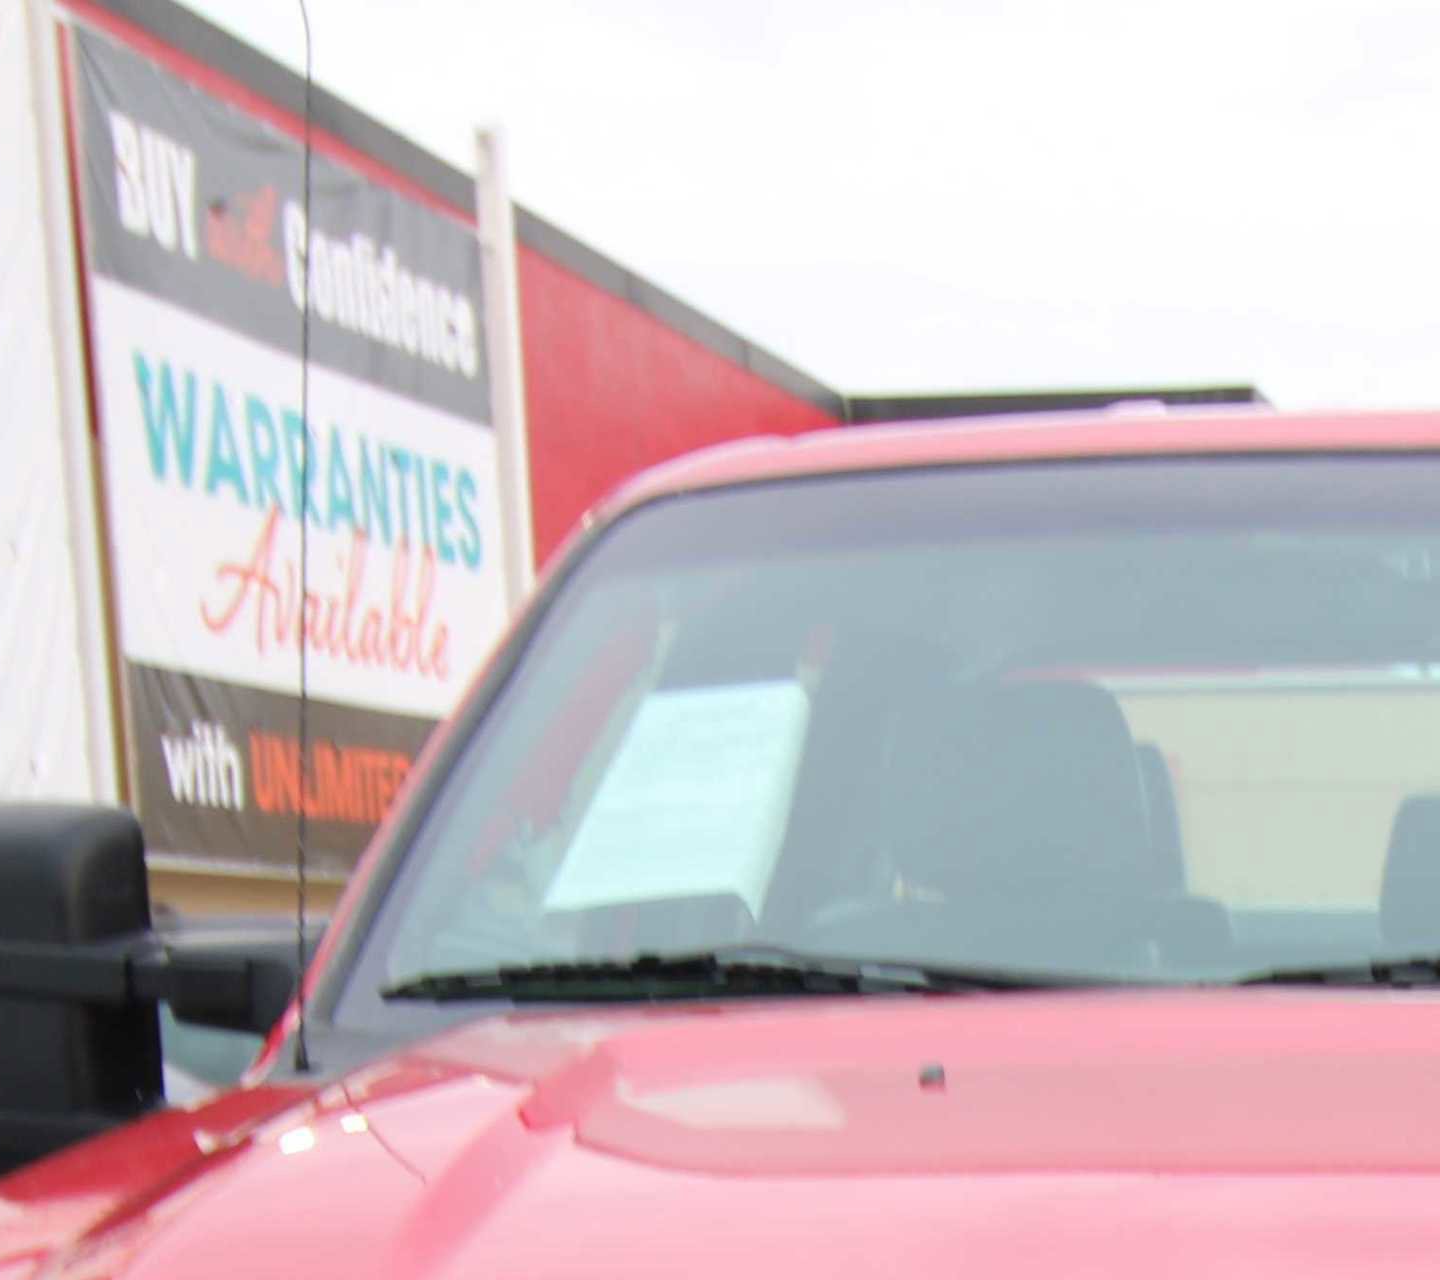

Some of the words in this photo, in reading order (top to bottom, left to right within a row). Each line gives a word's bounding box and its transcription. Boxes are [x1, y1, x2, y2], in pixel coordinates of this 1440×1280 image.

[109, 109, 197, 262] BUY
[282, 199, 478, 380] Confidence
[132, 349, 482, 570] WARRANTIES
[201, 504, 451, 681] Available
[161, 718, 244, 813] with
